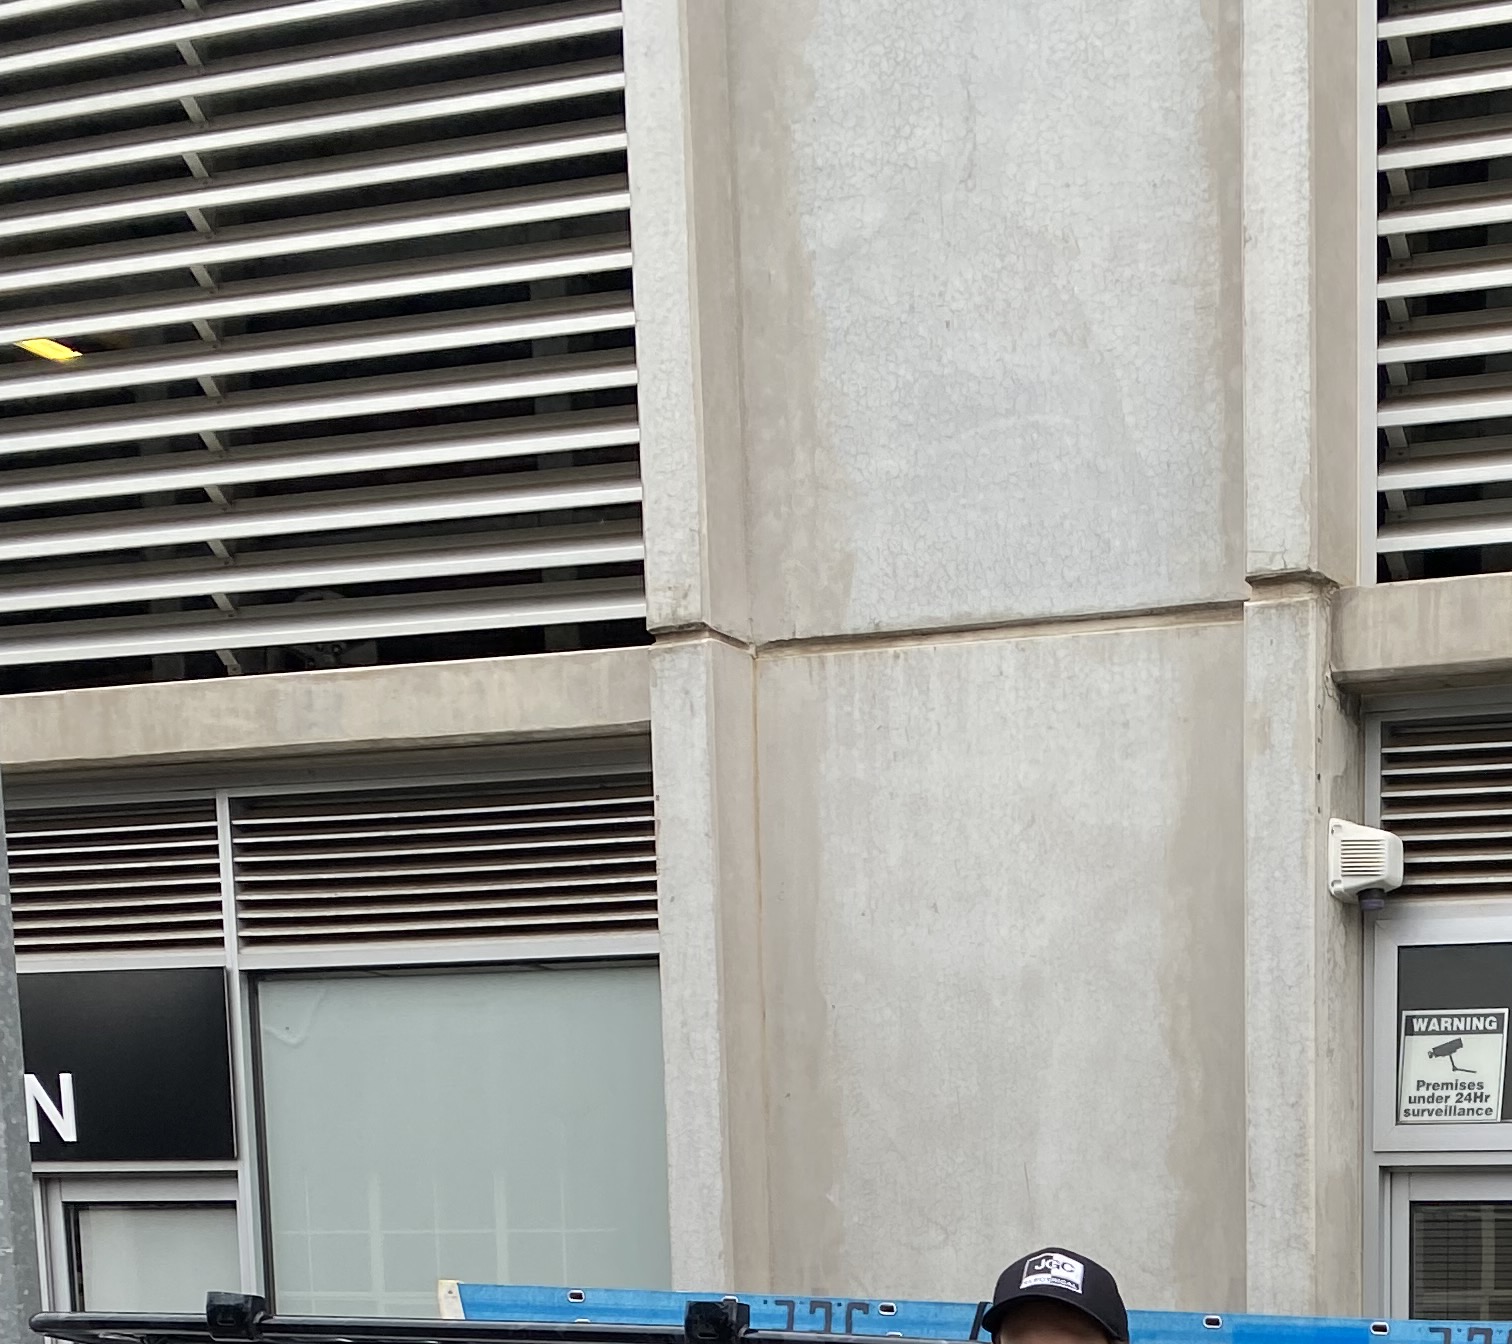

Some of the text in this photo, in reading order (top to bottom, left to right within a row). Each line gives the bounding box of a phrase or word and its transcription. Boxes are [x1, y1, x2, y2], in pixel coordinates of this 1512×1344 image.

[1412, 1016, 1499, 1032] WARNING
[1416, 1079, 1485, 1092] Premises
[1408, 1092, 1491, 1104] under 24Hr
[1403, 1105, 1494, 1118] surveillance
[1034, 1258, 1076, 1273] JGC
